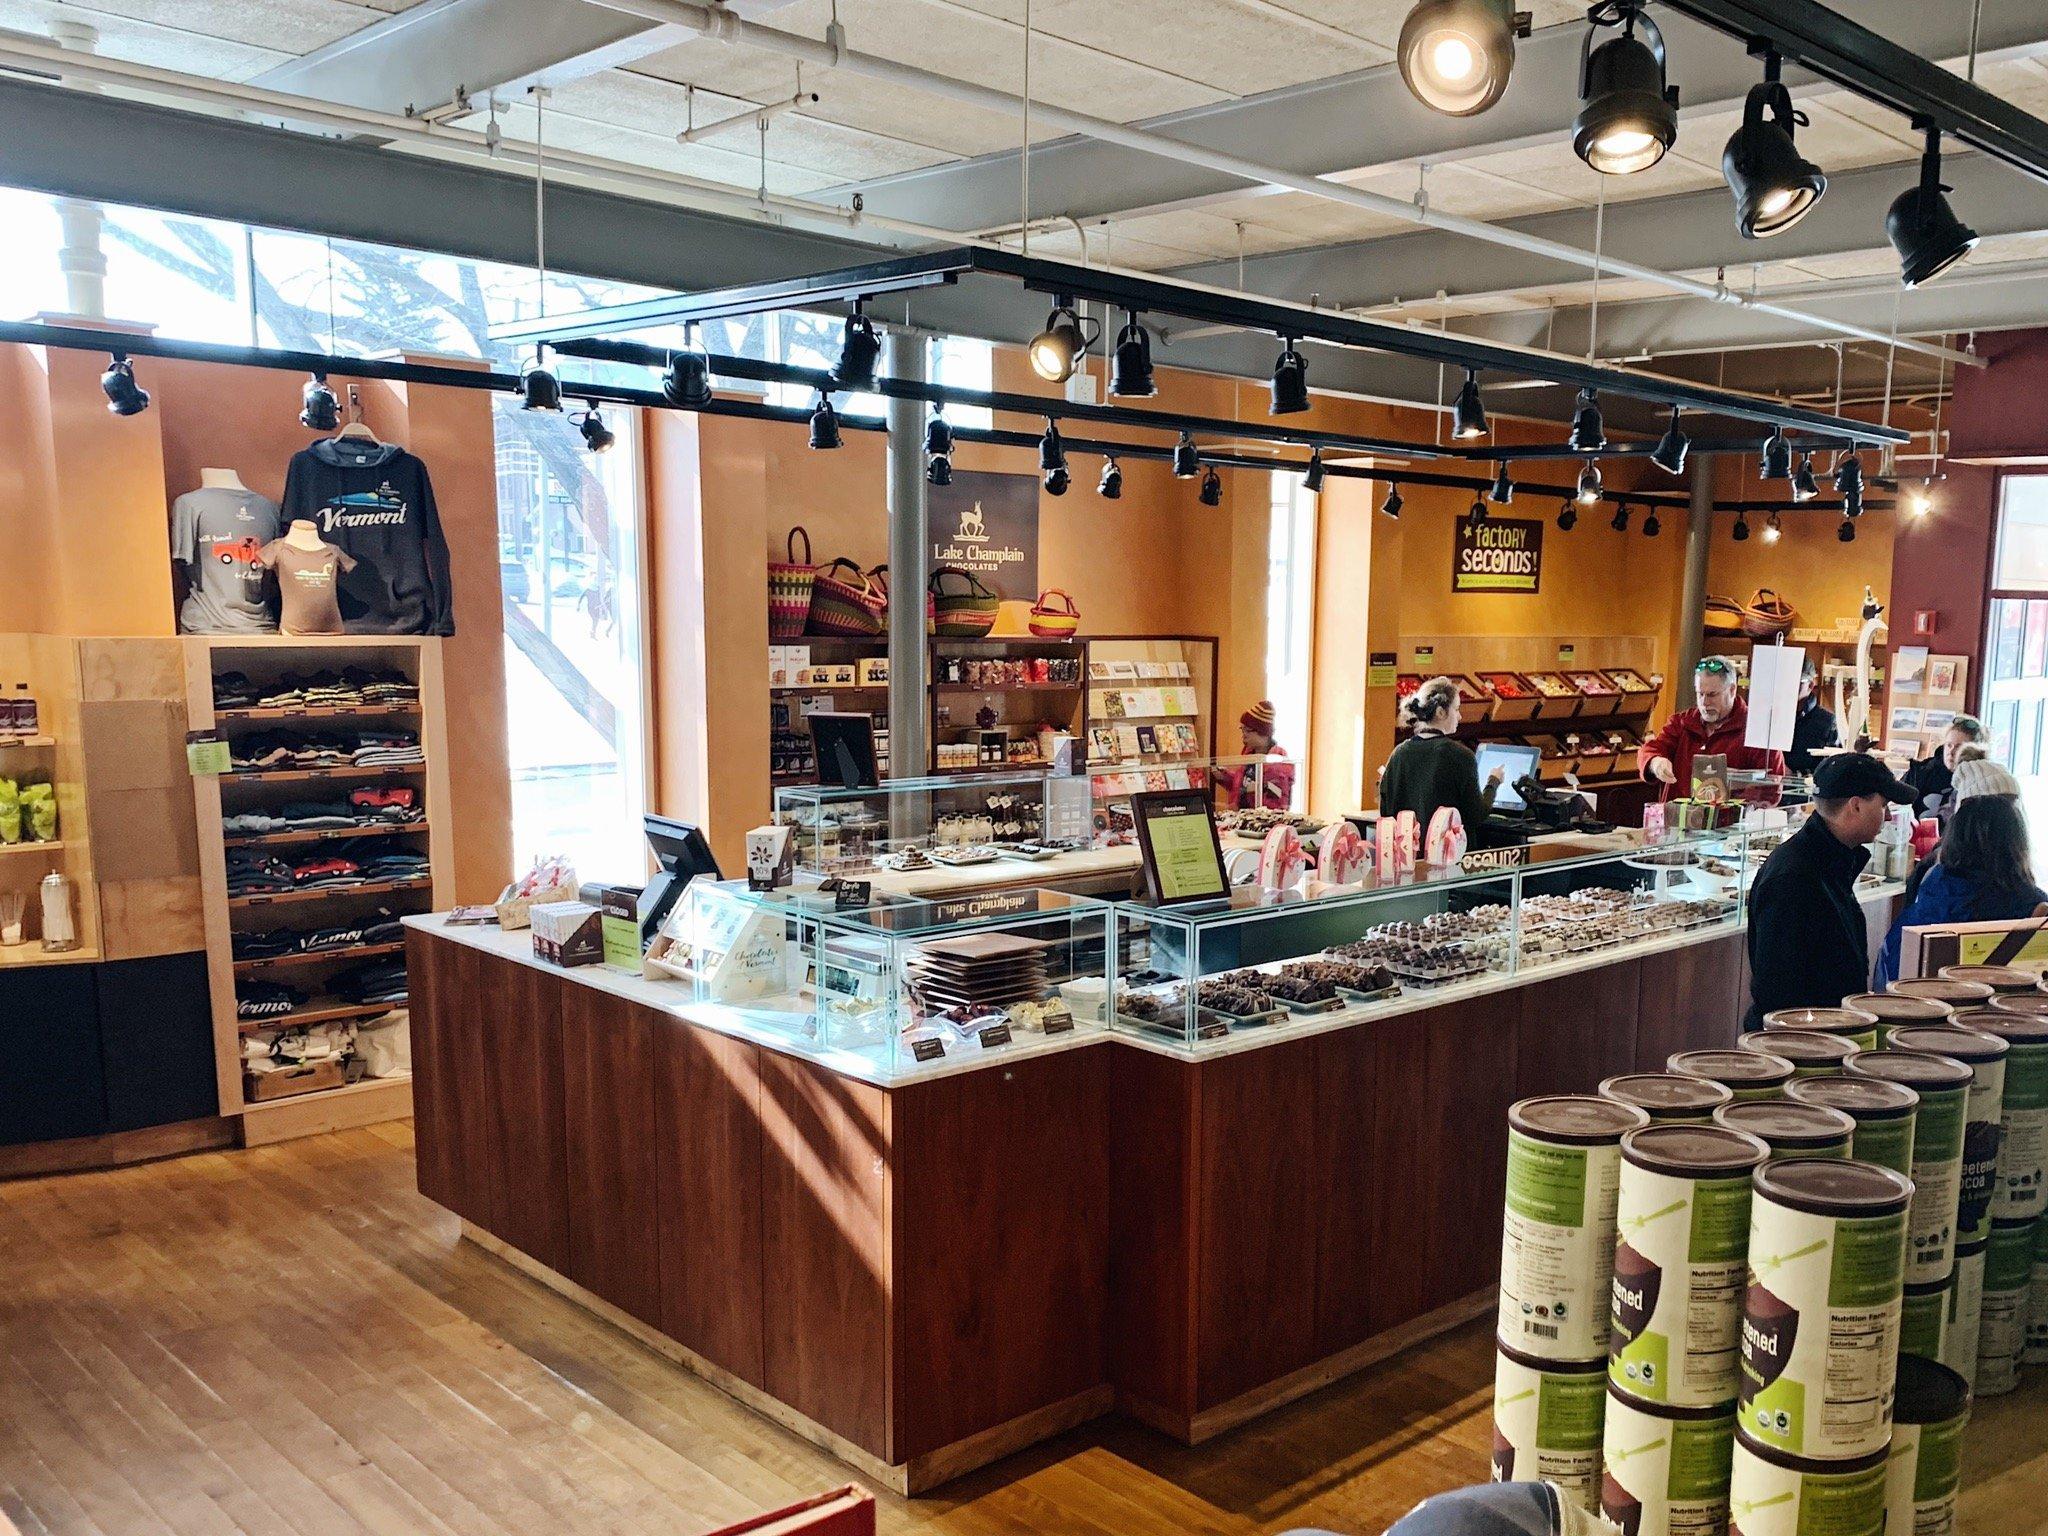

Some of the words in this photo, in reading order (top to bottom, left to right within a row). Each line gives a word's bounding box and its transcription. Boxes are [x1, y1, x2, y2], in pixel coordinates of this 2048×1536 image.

[316, 503, 407, 532] Vermont
[934, 543, 963, 560] Lake
[966, 544, 1025, 564] Champlain
[945, 562, 998, 572] CHOCOLATES
[1831, 1314, 1866, 1322] Nutrition
[1868, 1312, 1886, 1321] Facts
[1539, 1455, 1571, 1465] Nutrition
[1671, 1507, 1703, 1516] Nutrition
